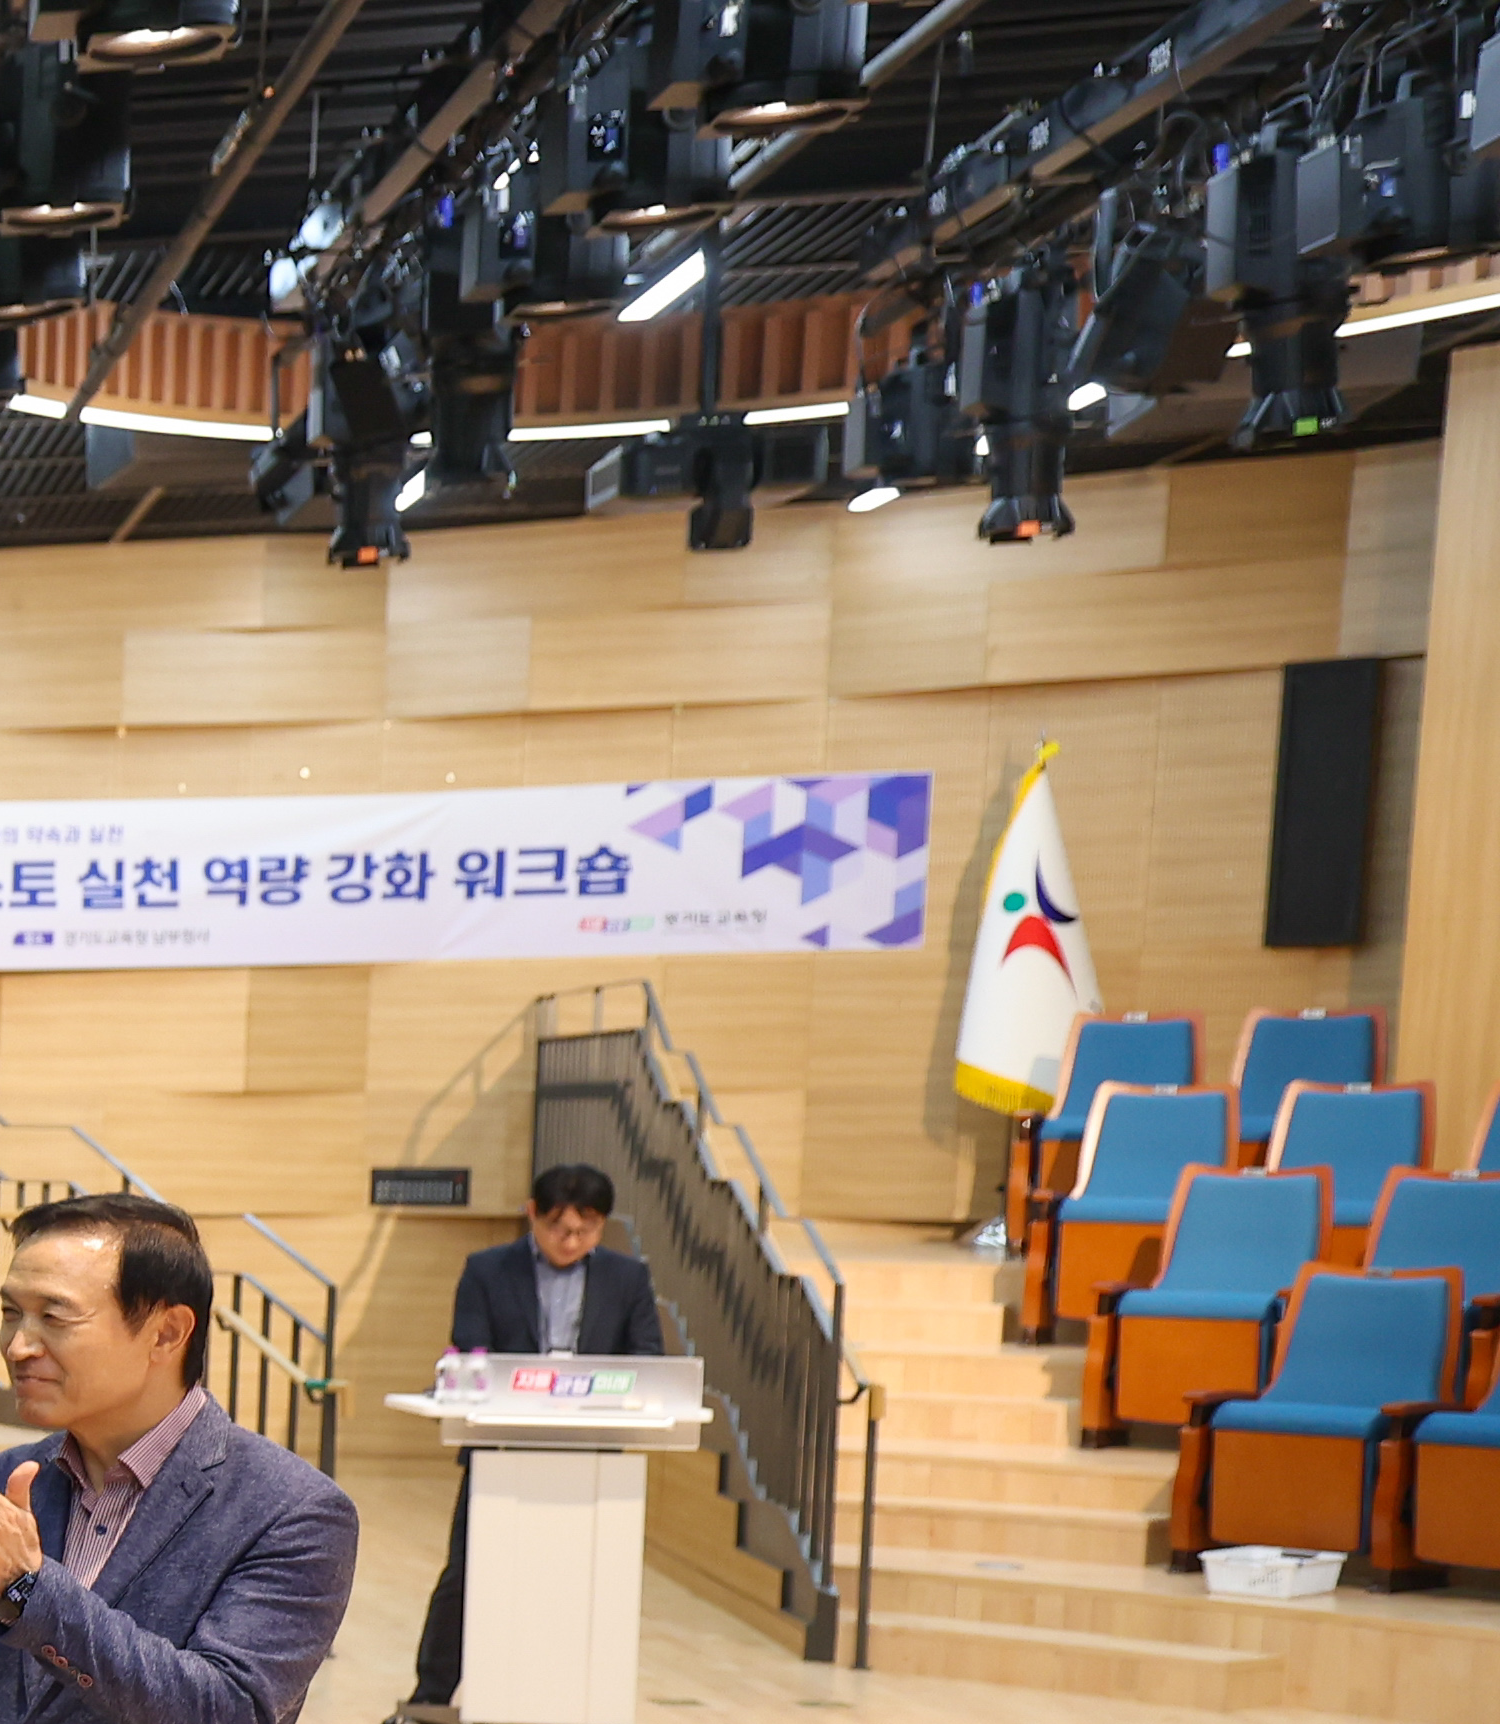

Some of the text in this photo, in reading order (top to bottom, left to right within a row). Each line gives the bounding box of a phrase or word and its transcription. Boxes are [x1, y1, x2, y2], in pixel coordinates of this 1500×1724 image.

[77, 855, 181, 911] 실천
[202, 854, 310, 907] 역량
[325, 849, 436, 904] 강화
[454, 844, 632, 901] 워크숍
